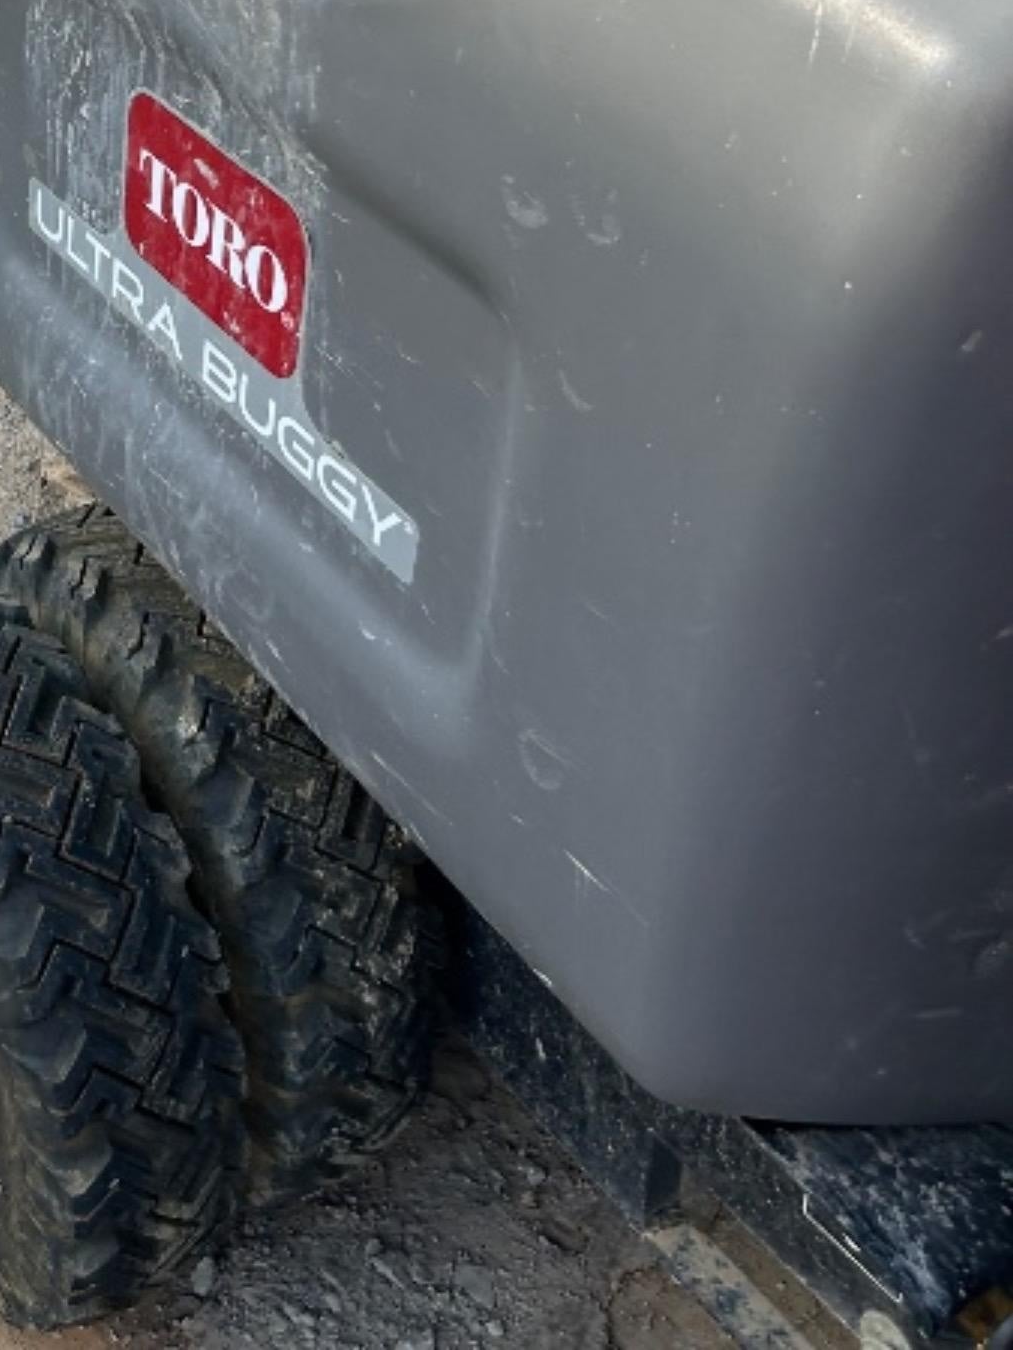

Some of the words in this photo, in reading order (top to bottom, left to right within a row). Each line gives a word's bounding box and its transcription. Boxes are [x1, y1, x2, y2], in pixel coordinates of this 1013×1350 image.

[139, 148, 288, 314] TORO
[36, 187, 183, 362] ULTRA
[201, 340, 401, 547] BUGGY
